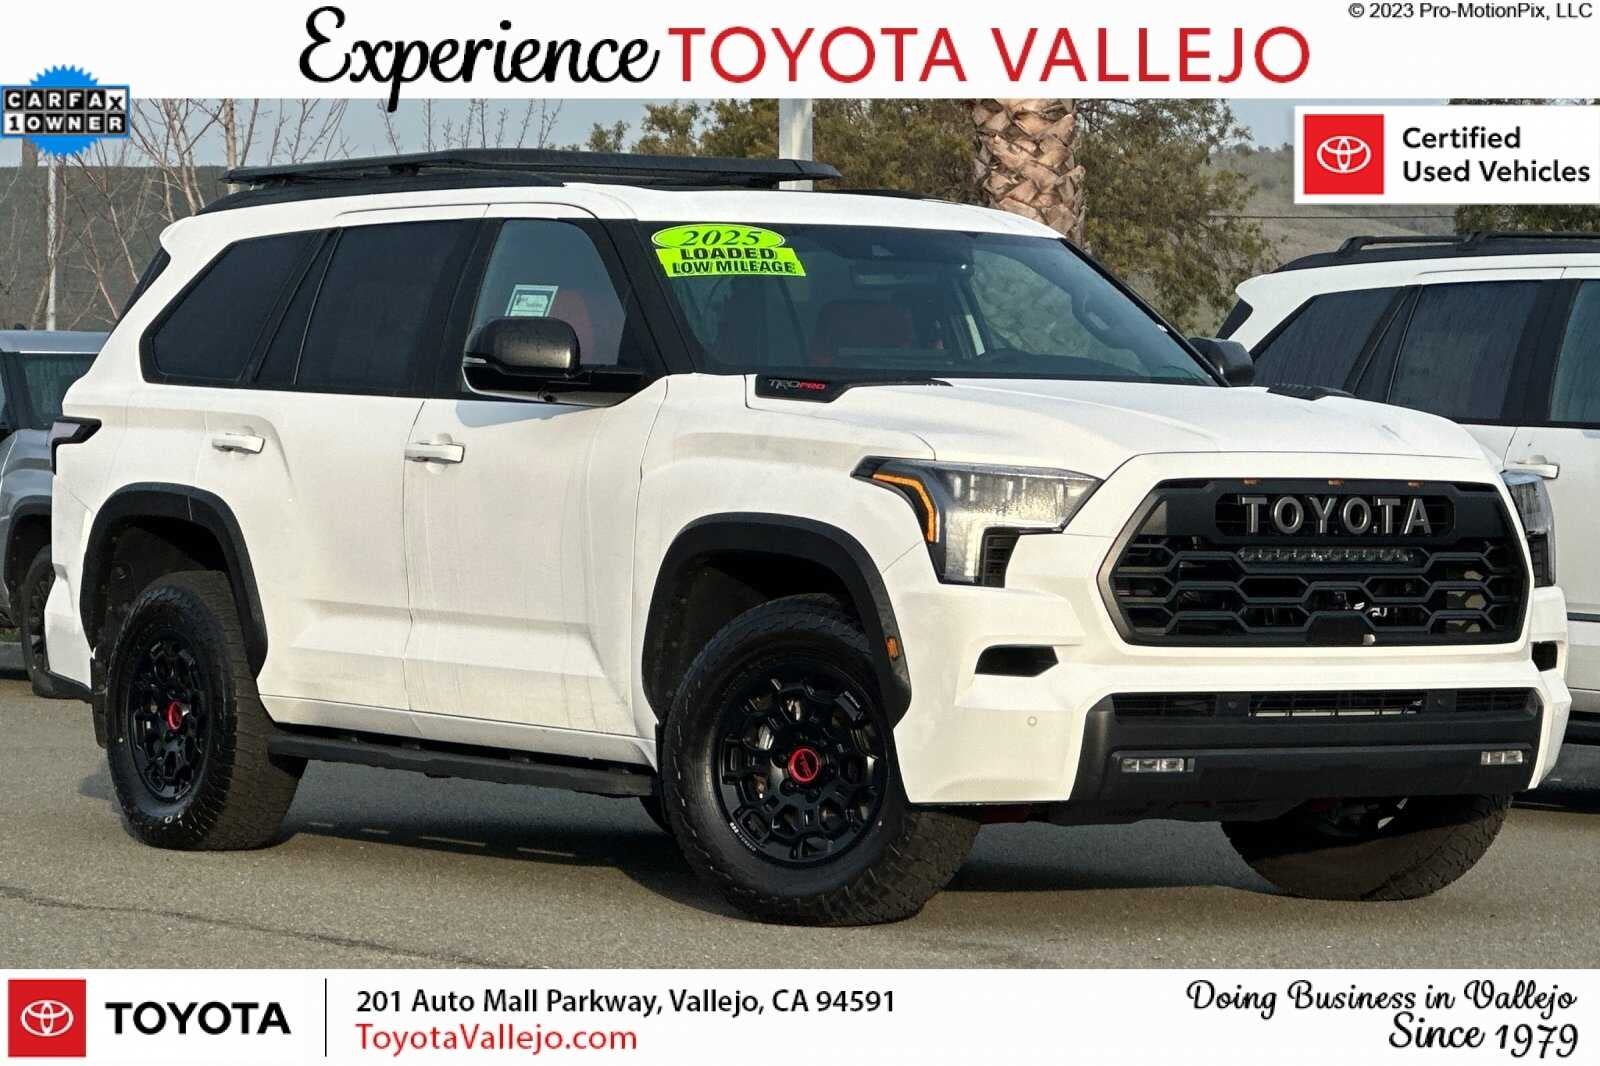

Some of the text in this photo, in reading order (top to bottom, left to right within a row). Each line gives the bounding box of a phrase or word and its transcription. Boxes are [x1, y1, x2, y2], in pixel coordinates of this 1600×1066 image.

[680, 230, 762, 246] 2025
[680, 247, 777, 260] LOADED
[672, 260, 796, 274] LOW MILEAGE
[1240, 496, 1432, 534] TOYOTA
